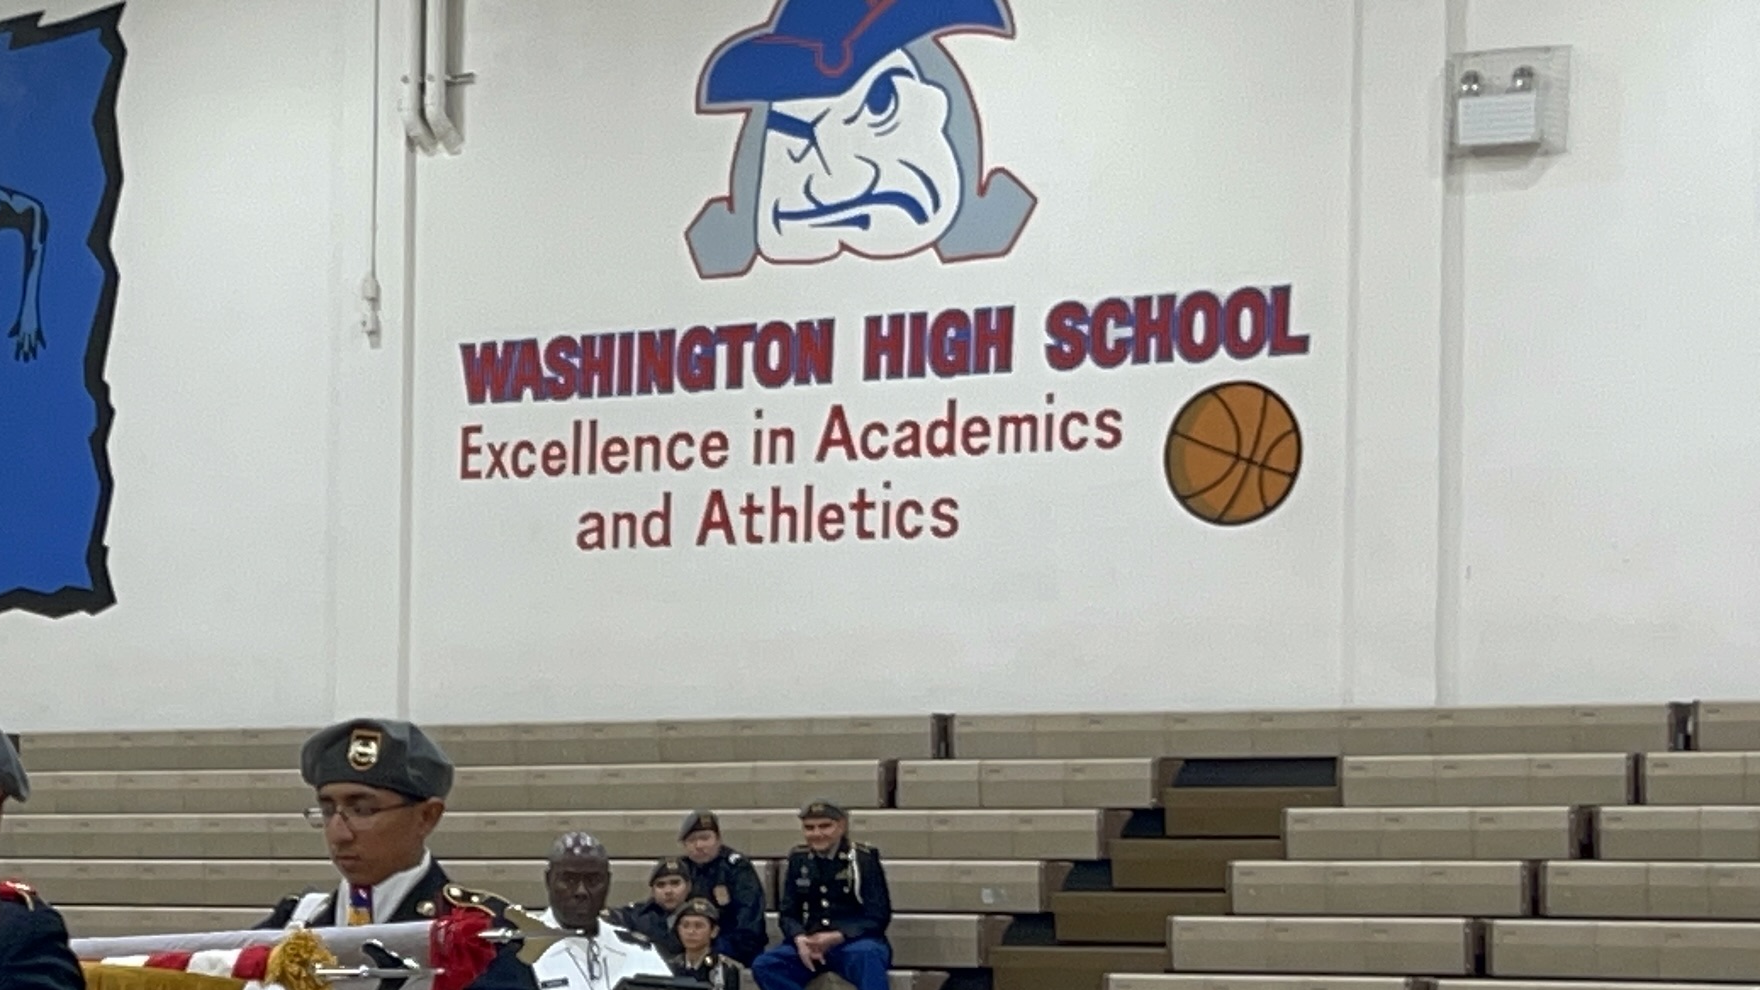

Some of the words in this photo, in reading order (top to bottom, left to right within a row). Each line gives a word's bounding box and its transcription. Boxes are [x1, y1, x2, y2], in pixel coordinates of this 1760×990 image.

[459, 317, 836, 405] WASHINGTON
[862, 305, 1016, 382] HIGH
[1044, 284, 1310, 371] SCHOOL
[460, 419, 729, 480] Excellence
[753, 410, 794, 465] in
[815, 393, 1123, 462] Academics
[576, 492, 672, 551] and
[695, 481, 960, 546] Athletics
